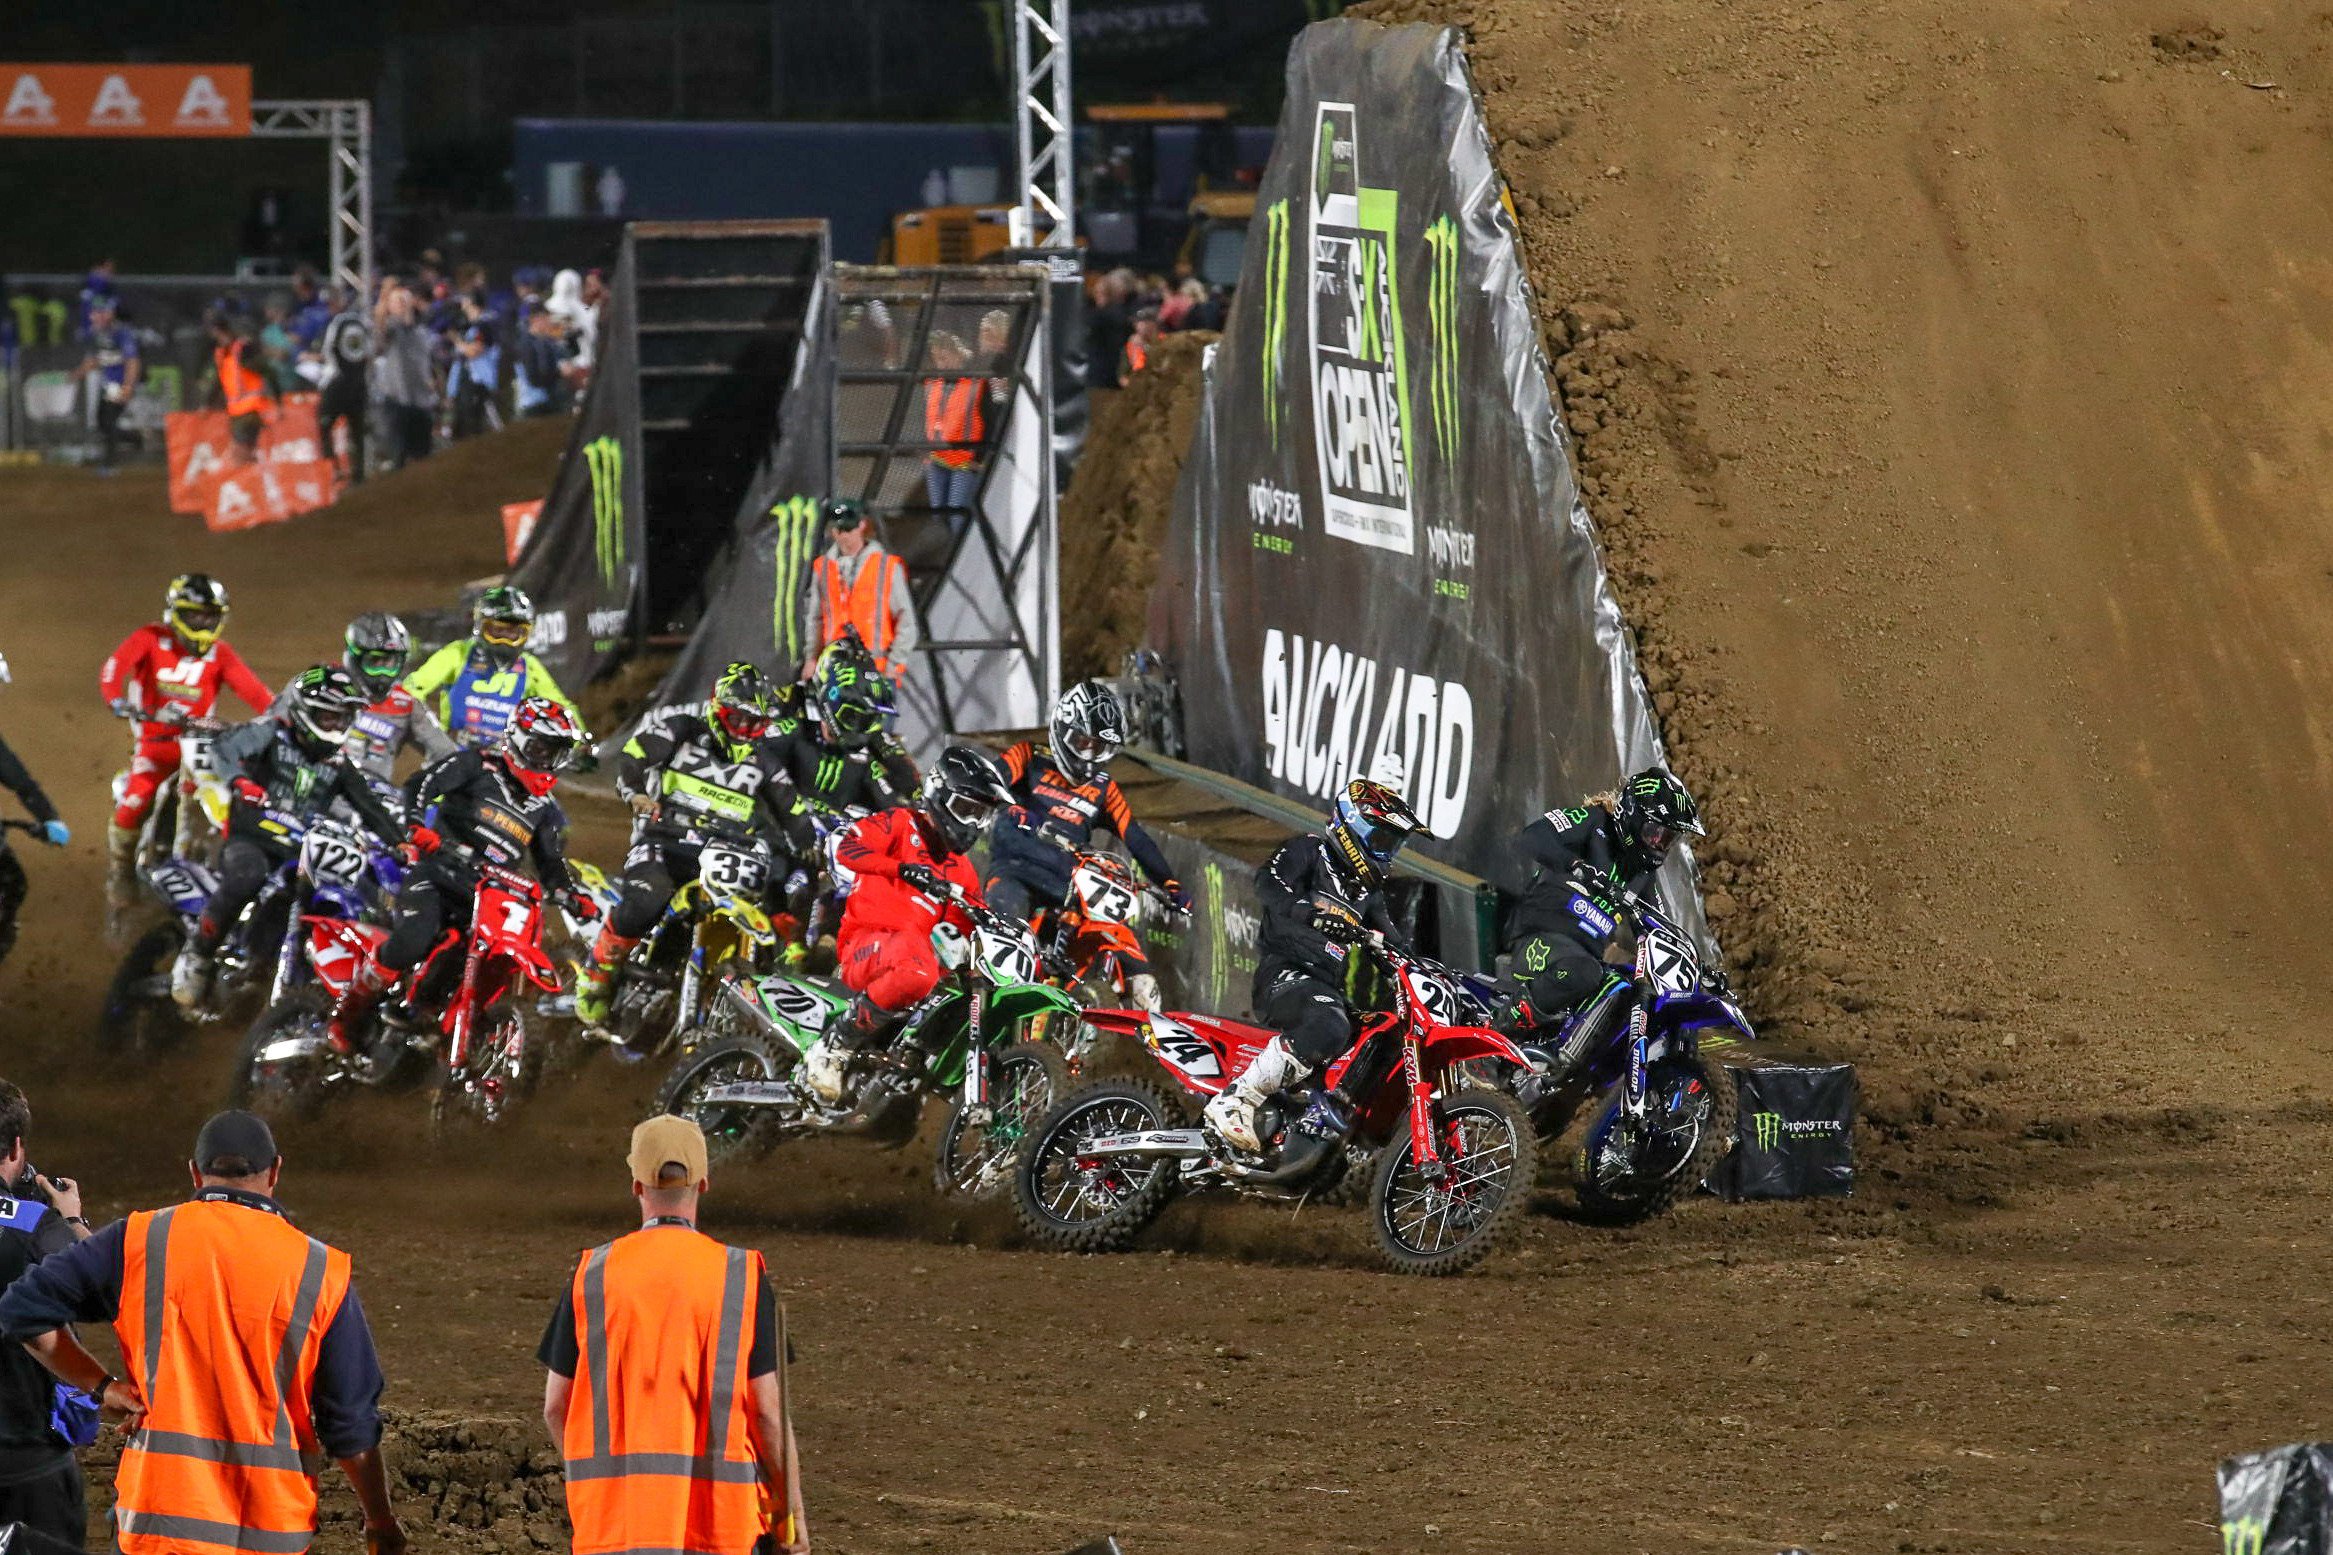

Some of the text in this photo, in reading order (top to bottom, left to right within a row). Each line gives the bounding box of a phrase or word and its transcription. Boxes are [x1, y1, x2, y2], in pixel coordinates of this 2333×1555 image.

[1377, 241, 1407, 498] AUCKLAND
[1320, 361, 1397, 498] OPEN
[1262, 628, 1474, 840] AUCKLAND
[669, 742, 766, 796] FXR
[311, 840, 364, 884] 122
[711, 852, 767, 890] 33
[1336, 825, 1370, 876] PENRITE
[501, 900, 531, 935] 1
[1090, 875, 1131, 921] 73
[1592, 895, 1614, 914] FOX
[1585, 905, 1614, 937] YAMAHA
[992, 937, 1033, 983] 70
[1654, 941, 1697, 992] 75
[763, 984, 817, 1015] 70
[1188, 1013, 1222, 1027] HONDA
[1155, 1029, 1214, 1066] 24
[1631, 1048, 1641, 1093] DUNLOP
[1781, 1119, 1842, 1133] MONSTER
[1790, 1131, 1833, 1140] ENERGY
